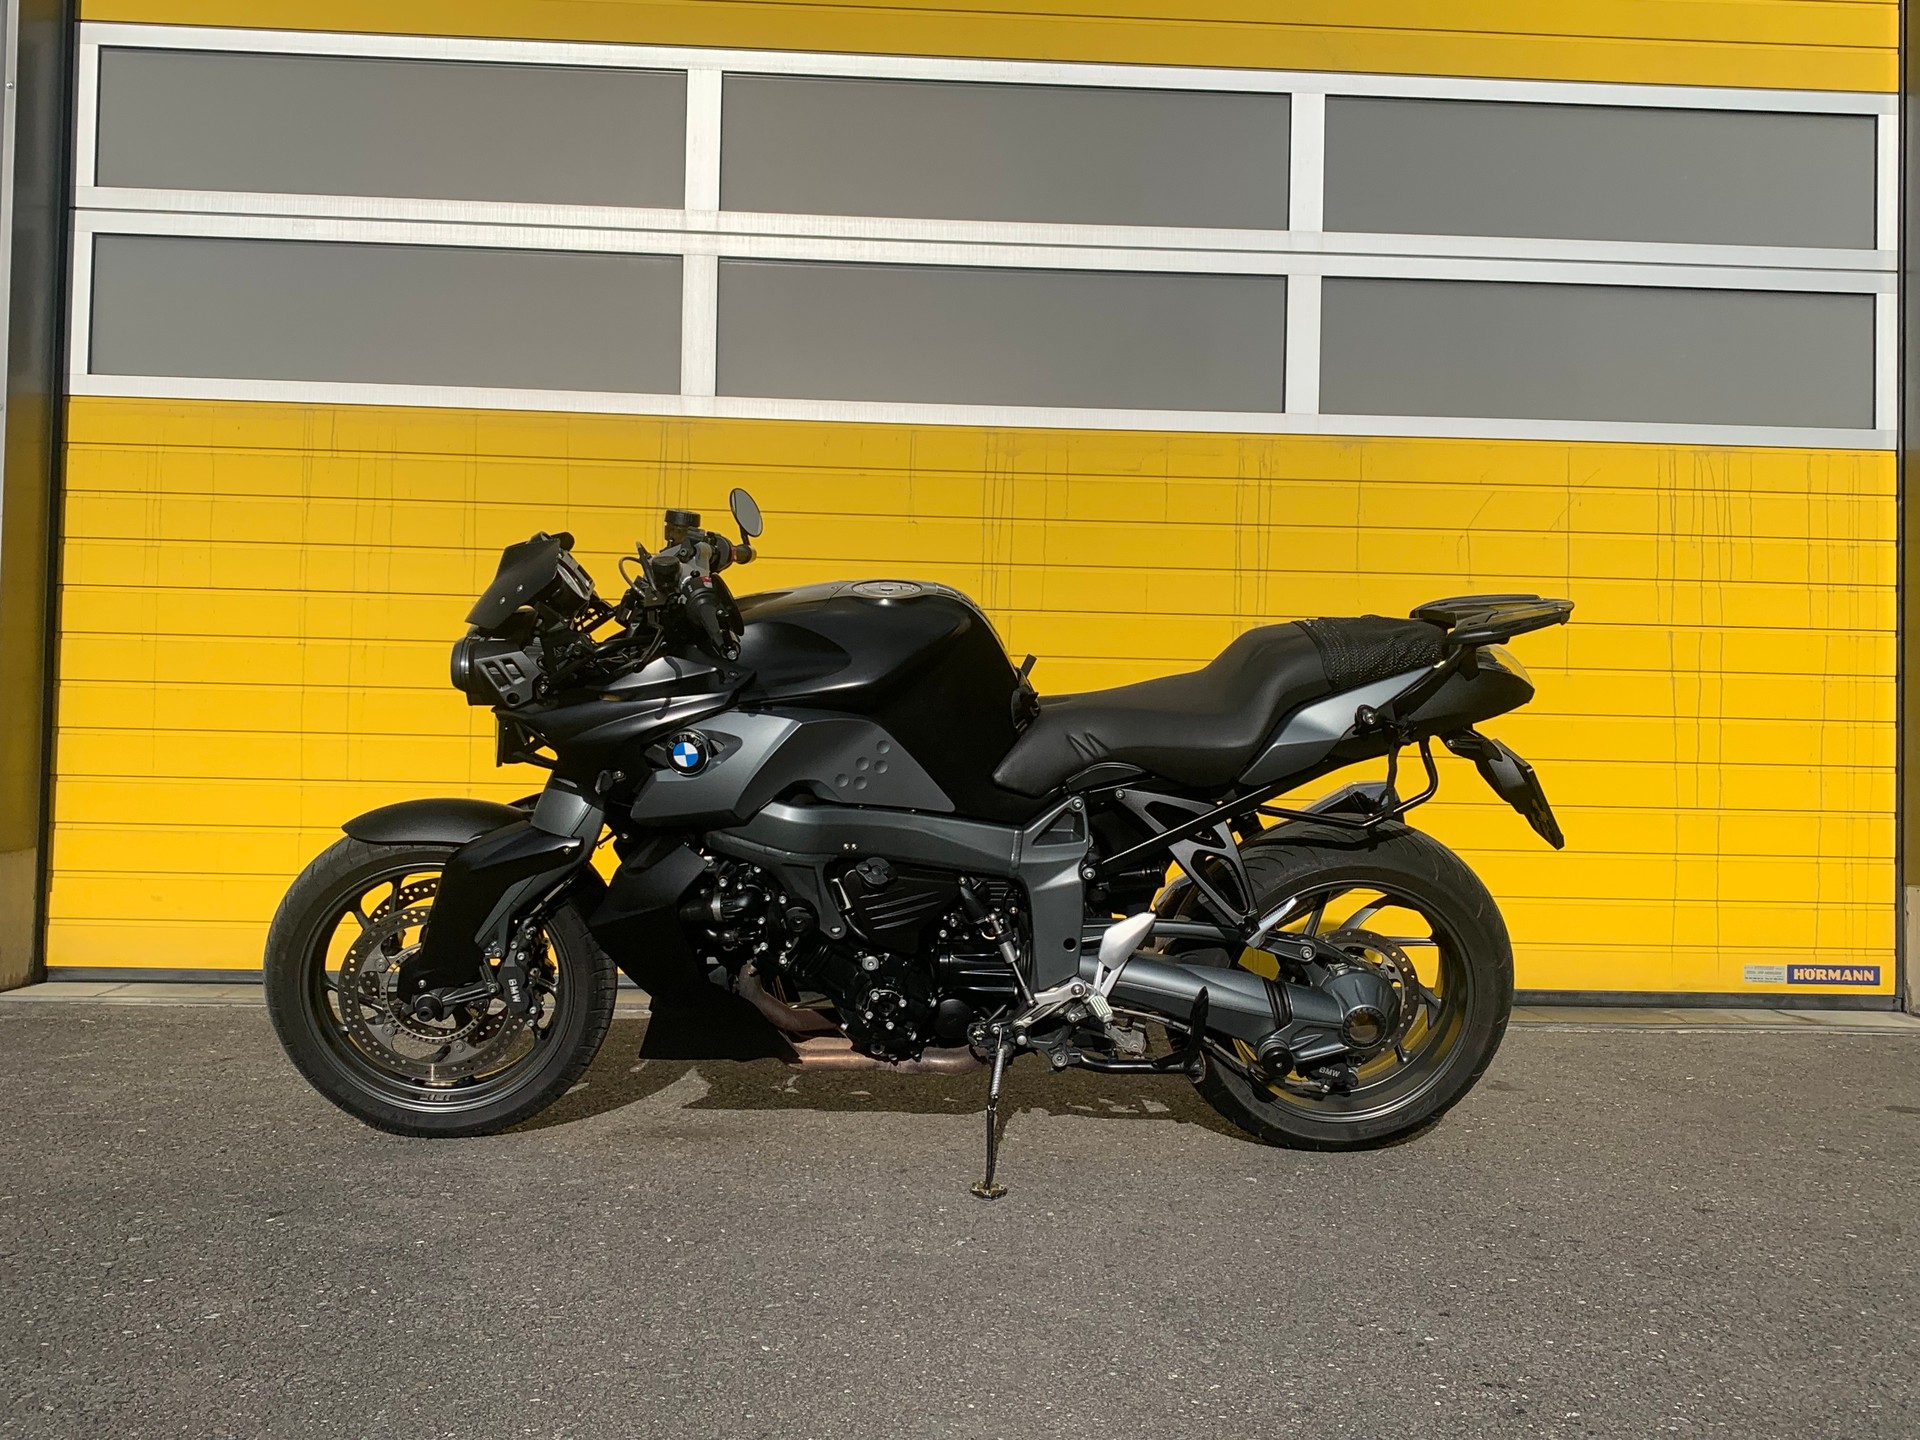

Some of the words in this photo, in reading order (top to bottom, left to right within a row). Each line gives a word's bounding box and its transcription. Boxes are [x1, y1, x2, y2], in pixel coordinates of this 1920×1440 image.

[668, 735, 702, 750] BMW
[1793, 967, 1875, 982] HÖRMANN
[508, 978, 521, 1003] BMW
[1318, 1066, 1341, 1078] BMW
